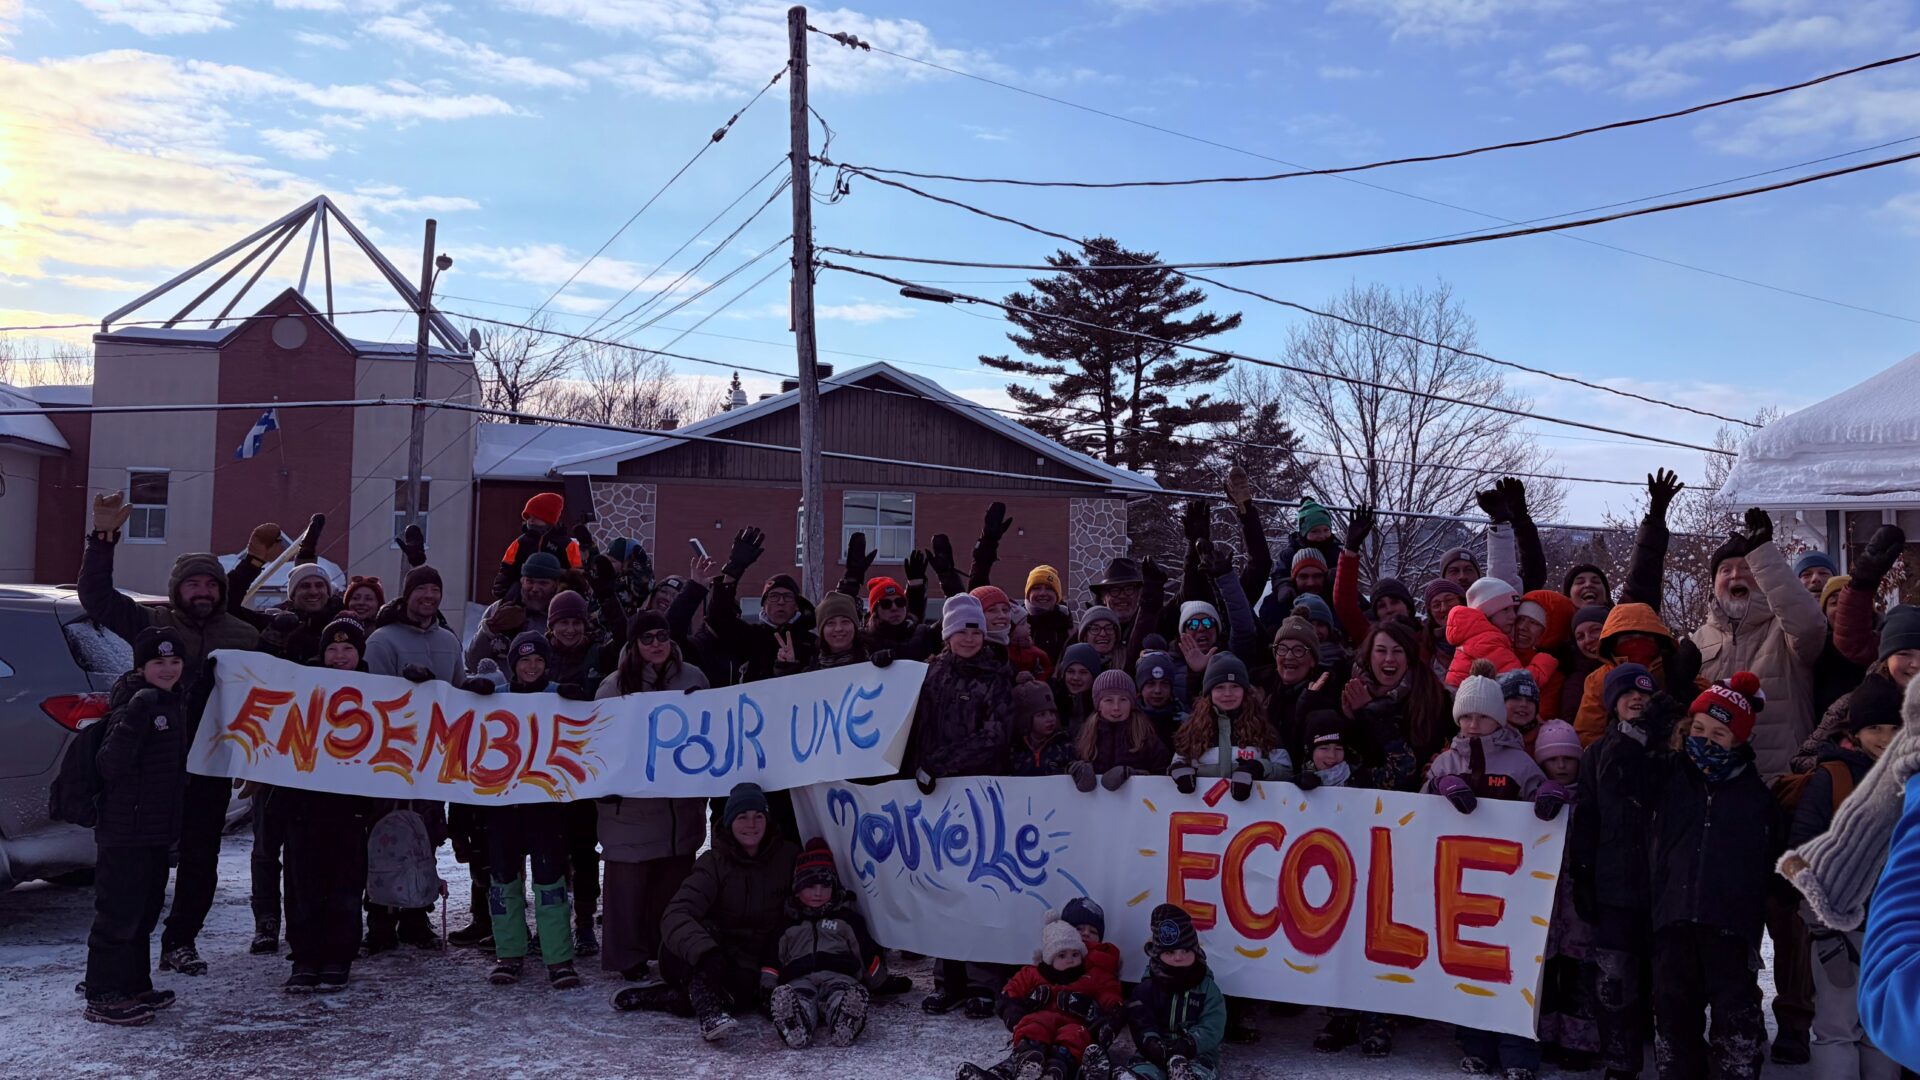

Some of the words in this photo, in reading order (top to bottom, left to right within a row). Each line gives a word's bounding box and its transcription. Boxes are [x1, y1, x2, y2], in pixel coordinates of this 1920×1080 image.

[227, 684, 597, 788] ENSEMBLE
[646, 692, 766, 782] POUR
[790, 683, 884, 763] UNE
[1488, 776, 1506, 787] HH
[1166, 778, 1523, 984] ÉCOLE
[821, 919, 838, 930] HH
